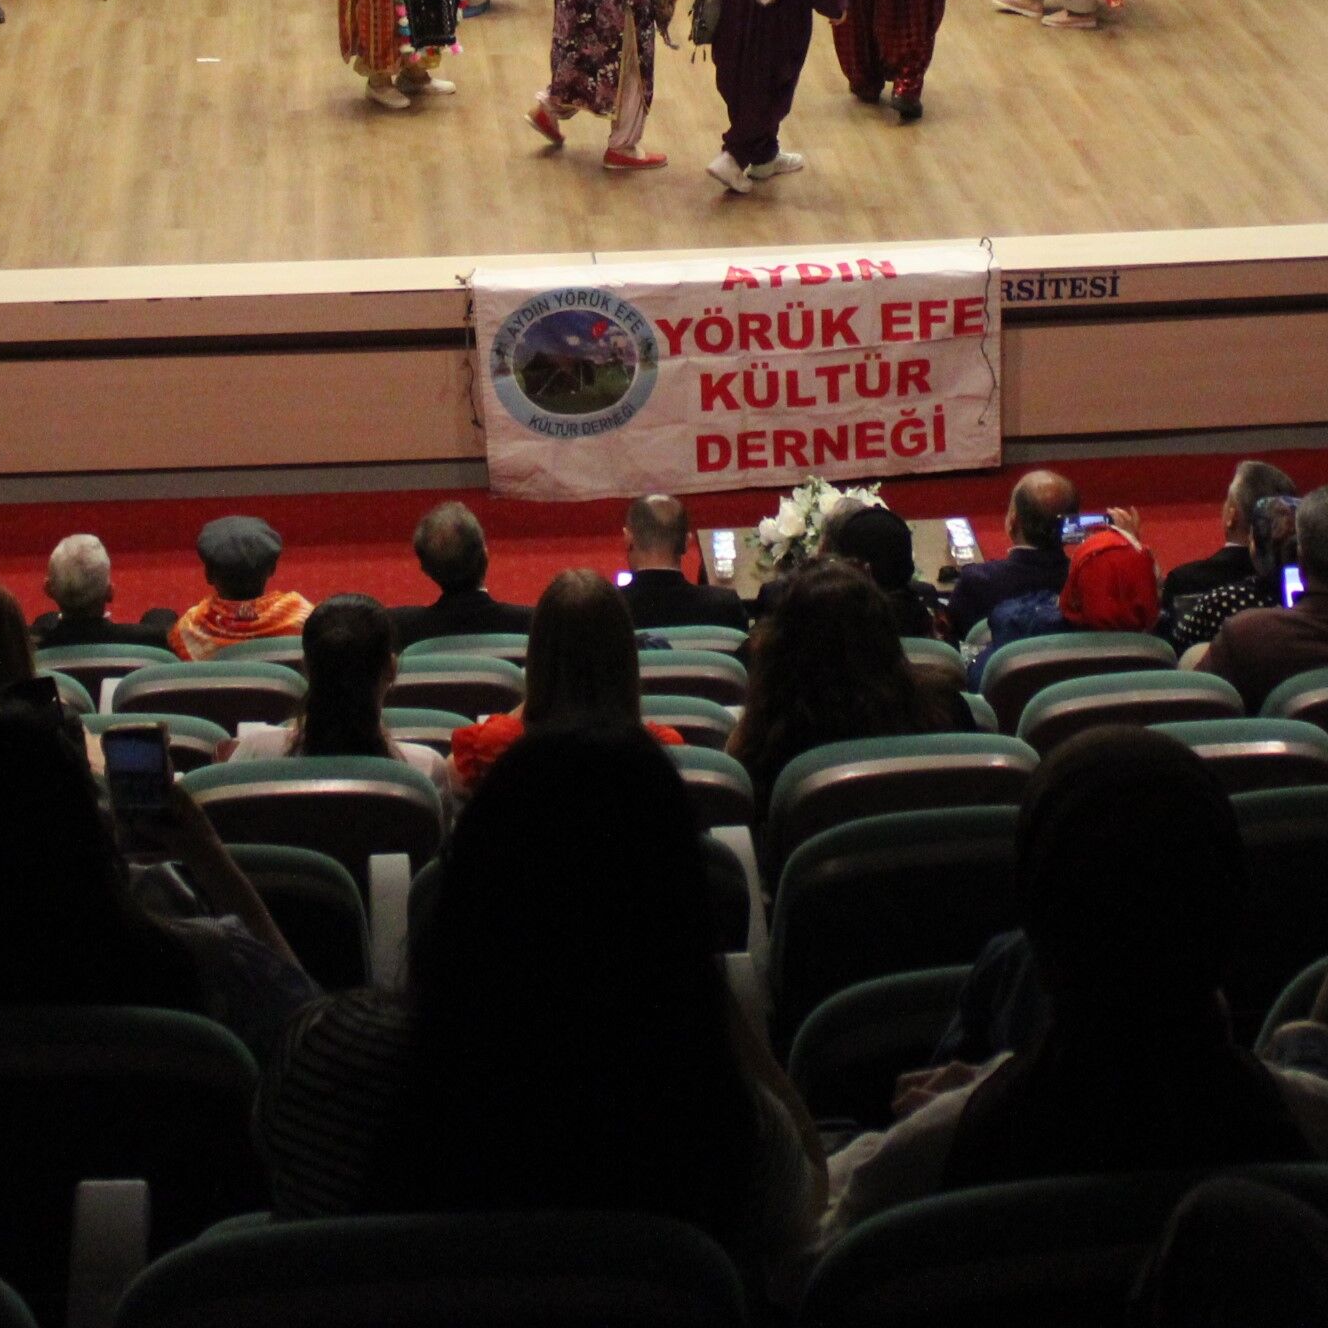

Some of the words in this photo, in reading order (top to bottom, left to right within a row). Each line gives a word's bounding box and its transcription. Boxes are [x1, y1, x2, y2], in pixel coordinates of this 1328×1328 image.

[721, 258, 897, 291] AYDIN
[1001, 270, 1120, 301] RSİTESİ
[507, 299, 550, 339] AYDIN
[555, 289, 611, 312] YÖRÜK
[614, 304, 646, 334] EFE
[654, 301, 860, 357] YÖRÜK
[880, 296, 985, 343] EFE
[699, 353, 932, 412] KÜLTÜR
[528, 414, 578, 436] KÜLTÜR
[695, 404, 947, 473] DERNEĞİ
